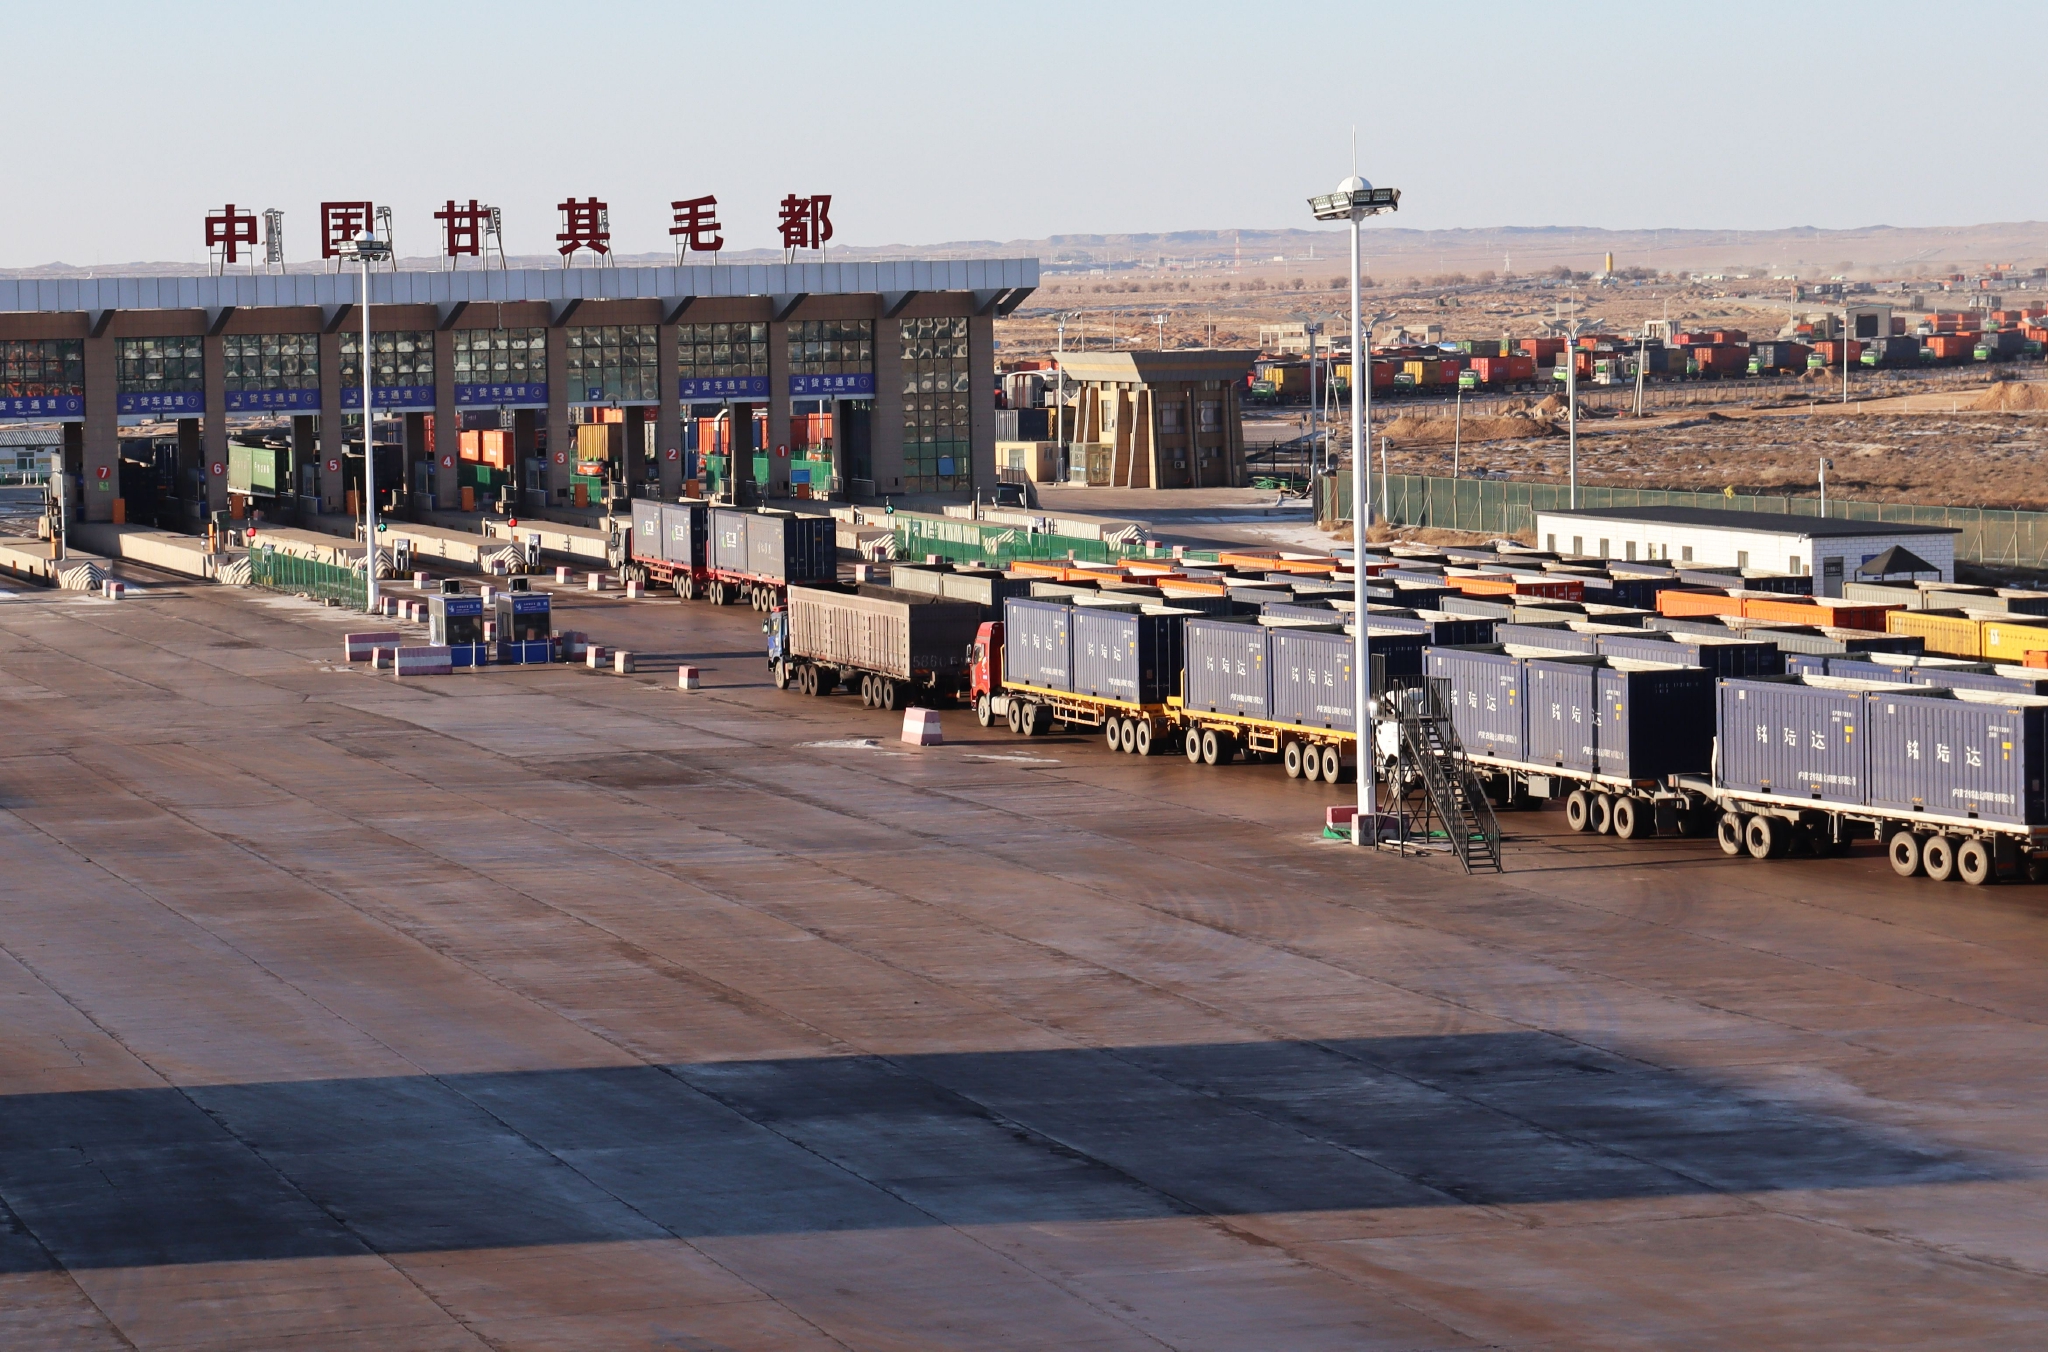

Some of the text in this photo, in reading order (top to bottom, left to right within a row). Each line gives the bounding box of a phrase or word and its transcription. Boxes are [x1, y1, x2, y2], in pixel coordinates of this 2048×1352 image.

[205, 193, 833, 263] 中国甘其毛都
[702, 380, 747, 390] 货车通道
[811, 377, 855, 387] 货车通道
[479, 387, 526, 397] 货车通道
[140, 396, 184, 406] 货车通道
[250, 393, 297, 403] 货车通道
